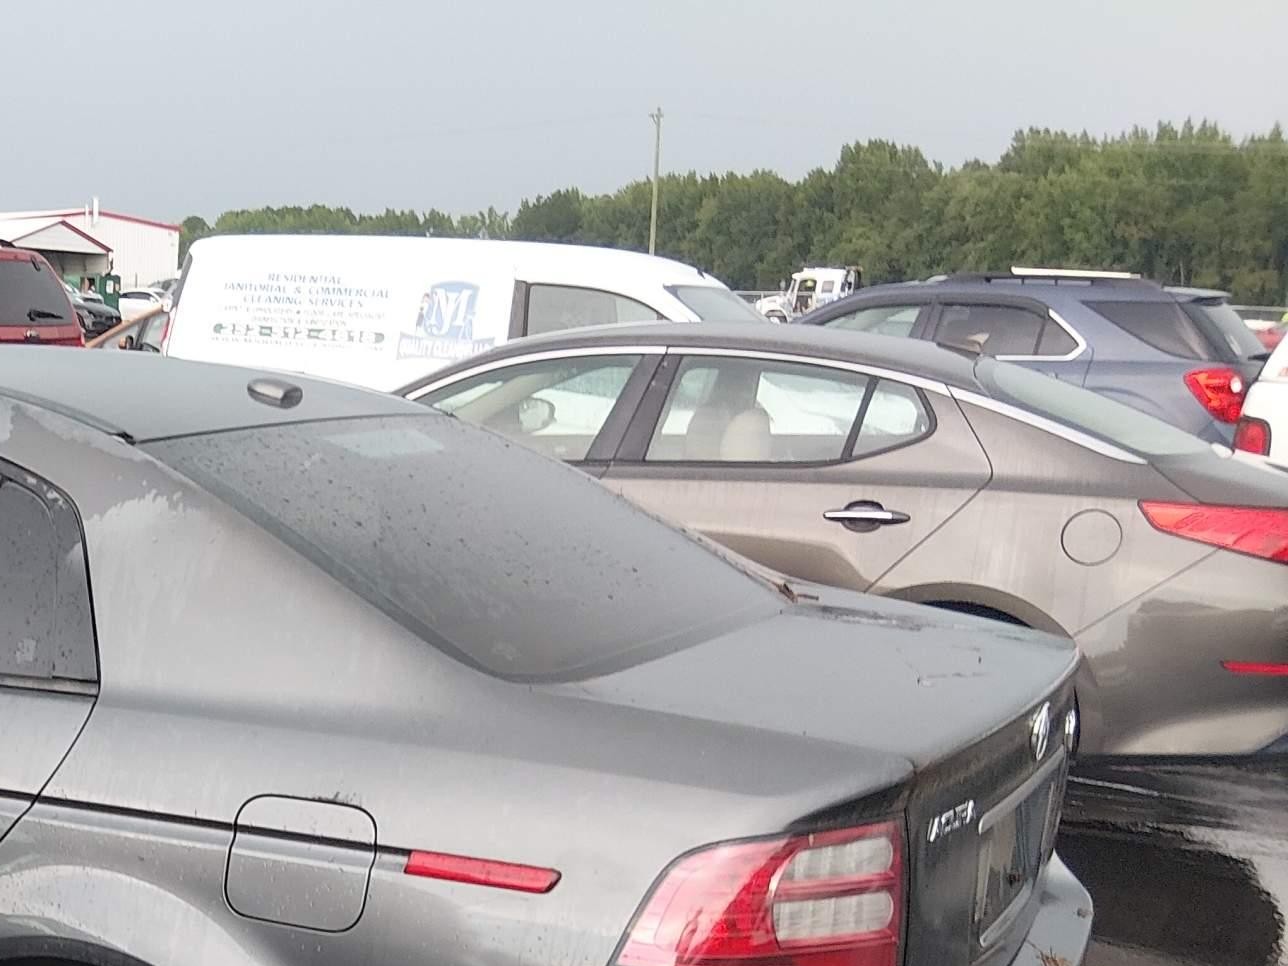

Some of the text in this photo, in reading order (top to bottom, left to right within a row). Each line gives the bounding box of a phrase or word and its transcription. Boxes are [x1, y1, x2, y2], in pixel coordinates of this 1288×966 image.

[267, 273, 342, 285] RESIDENTIAL
[224, 282, 287, 294] JANITORIAL
[308, 287, 390, 299] COMMERCIAL
[243, 295, 364, 308] CLEANING SERVICES
